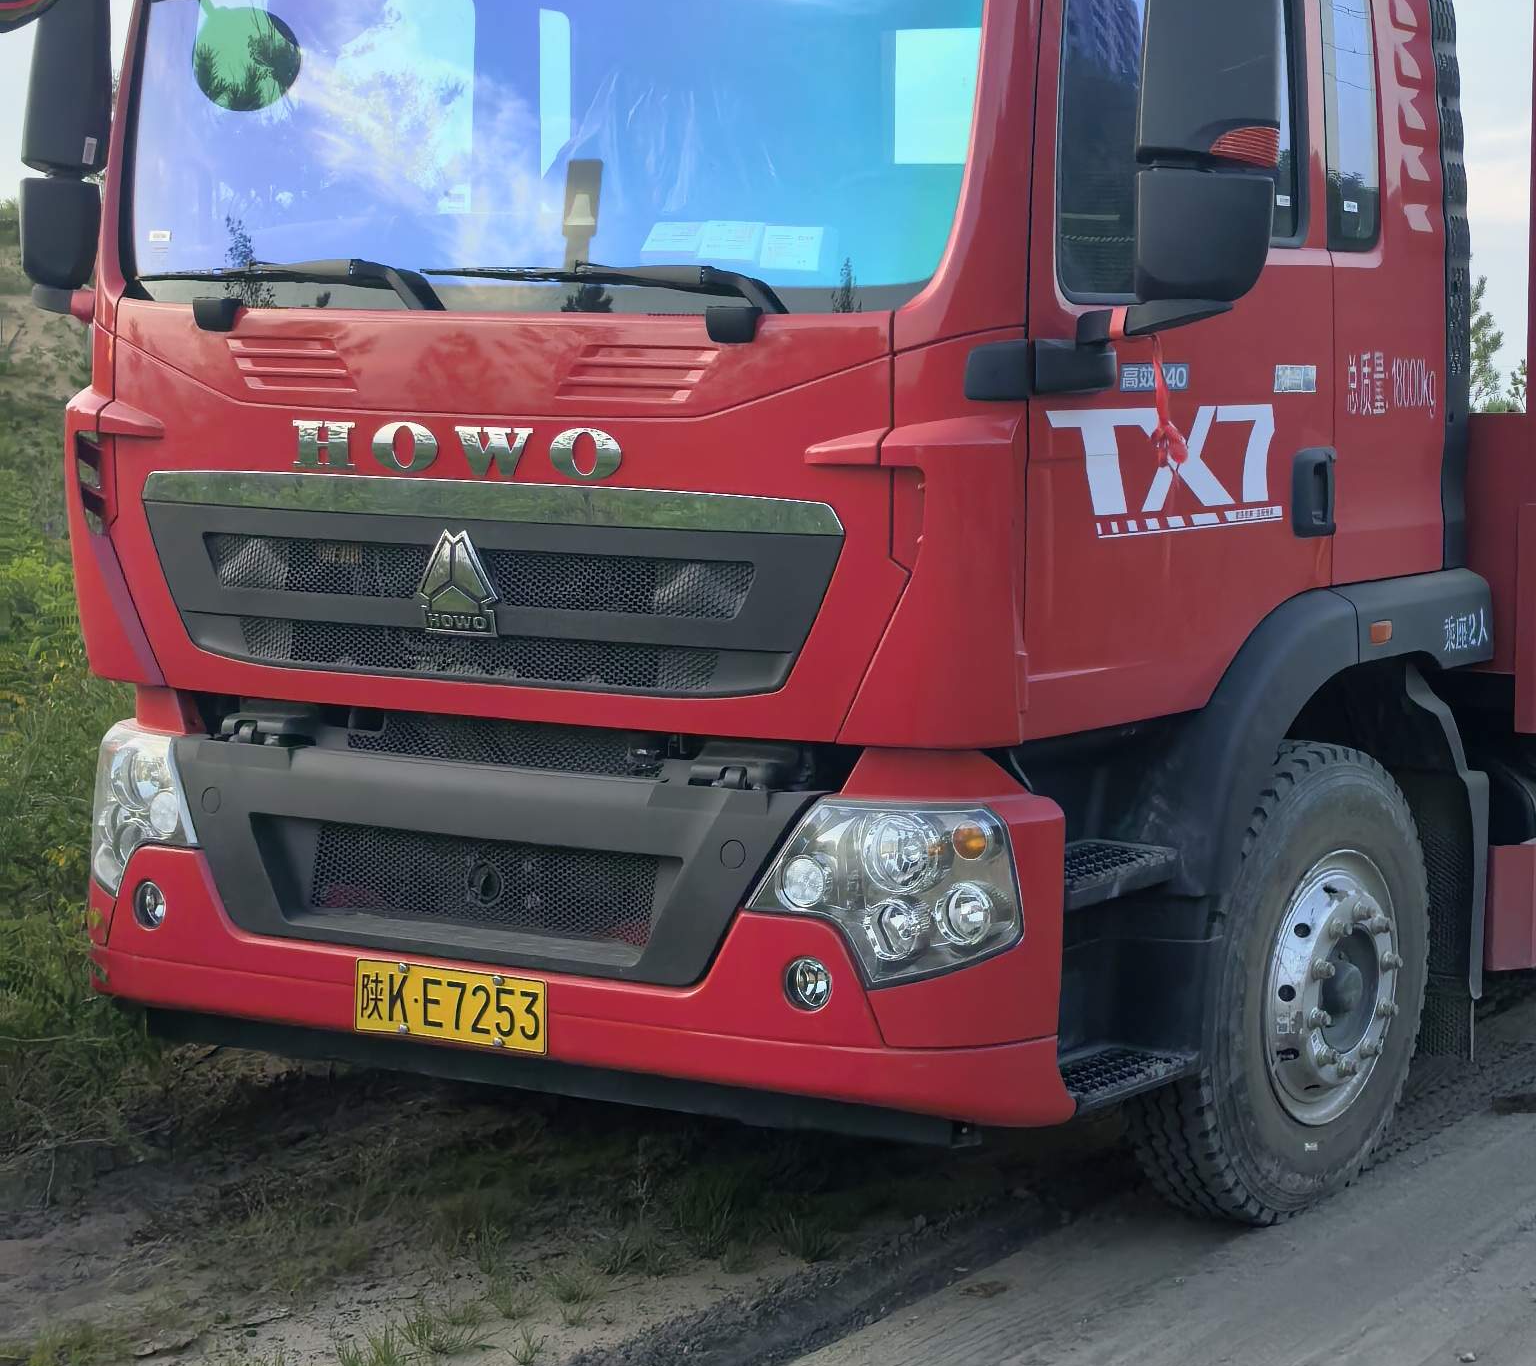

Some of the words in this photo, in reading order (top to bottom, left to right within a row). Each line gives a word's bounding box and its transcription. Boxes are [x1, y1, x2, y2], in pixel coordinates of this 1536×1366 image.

[1122, 366, 1187, 389] 高效40
[292, 419, 623, 481] HOWO
[1046, 404, 1275, 516] TX7
[427, 612, 488, 630] HOWO
